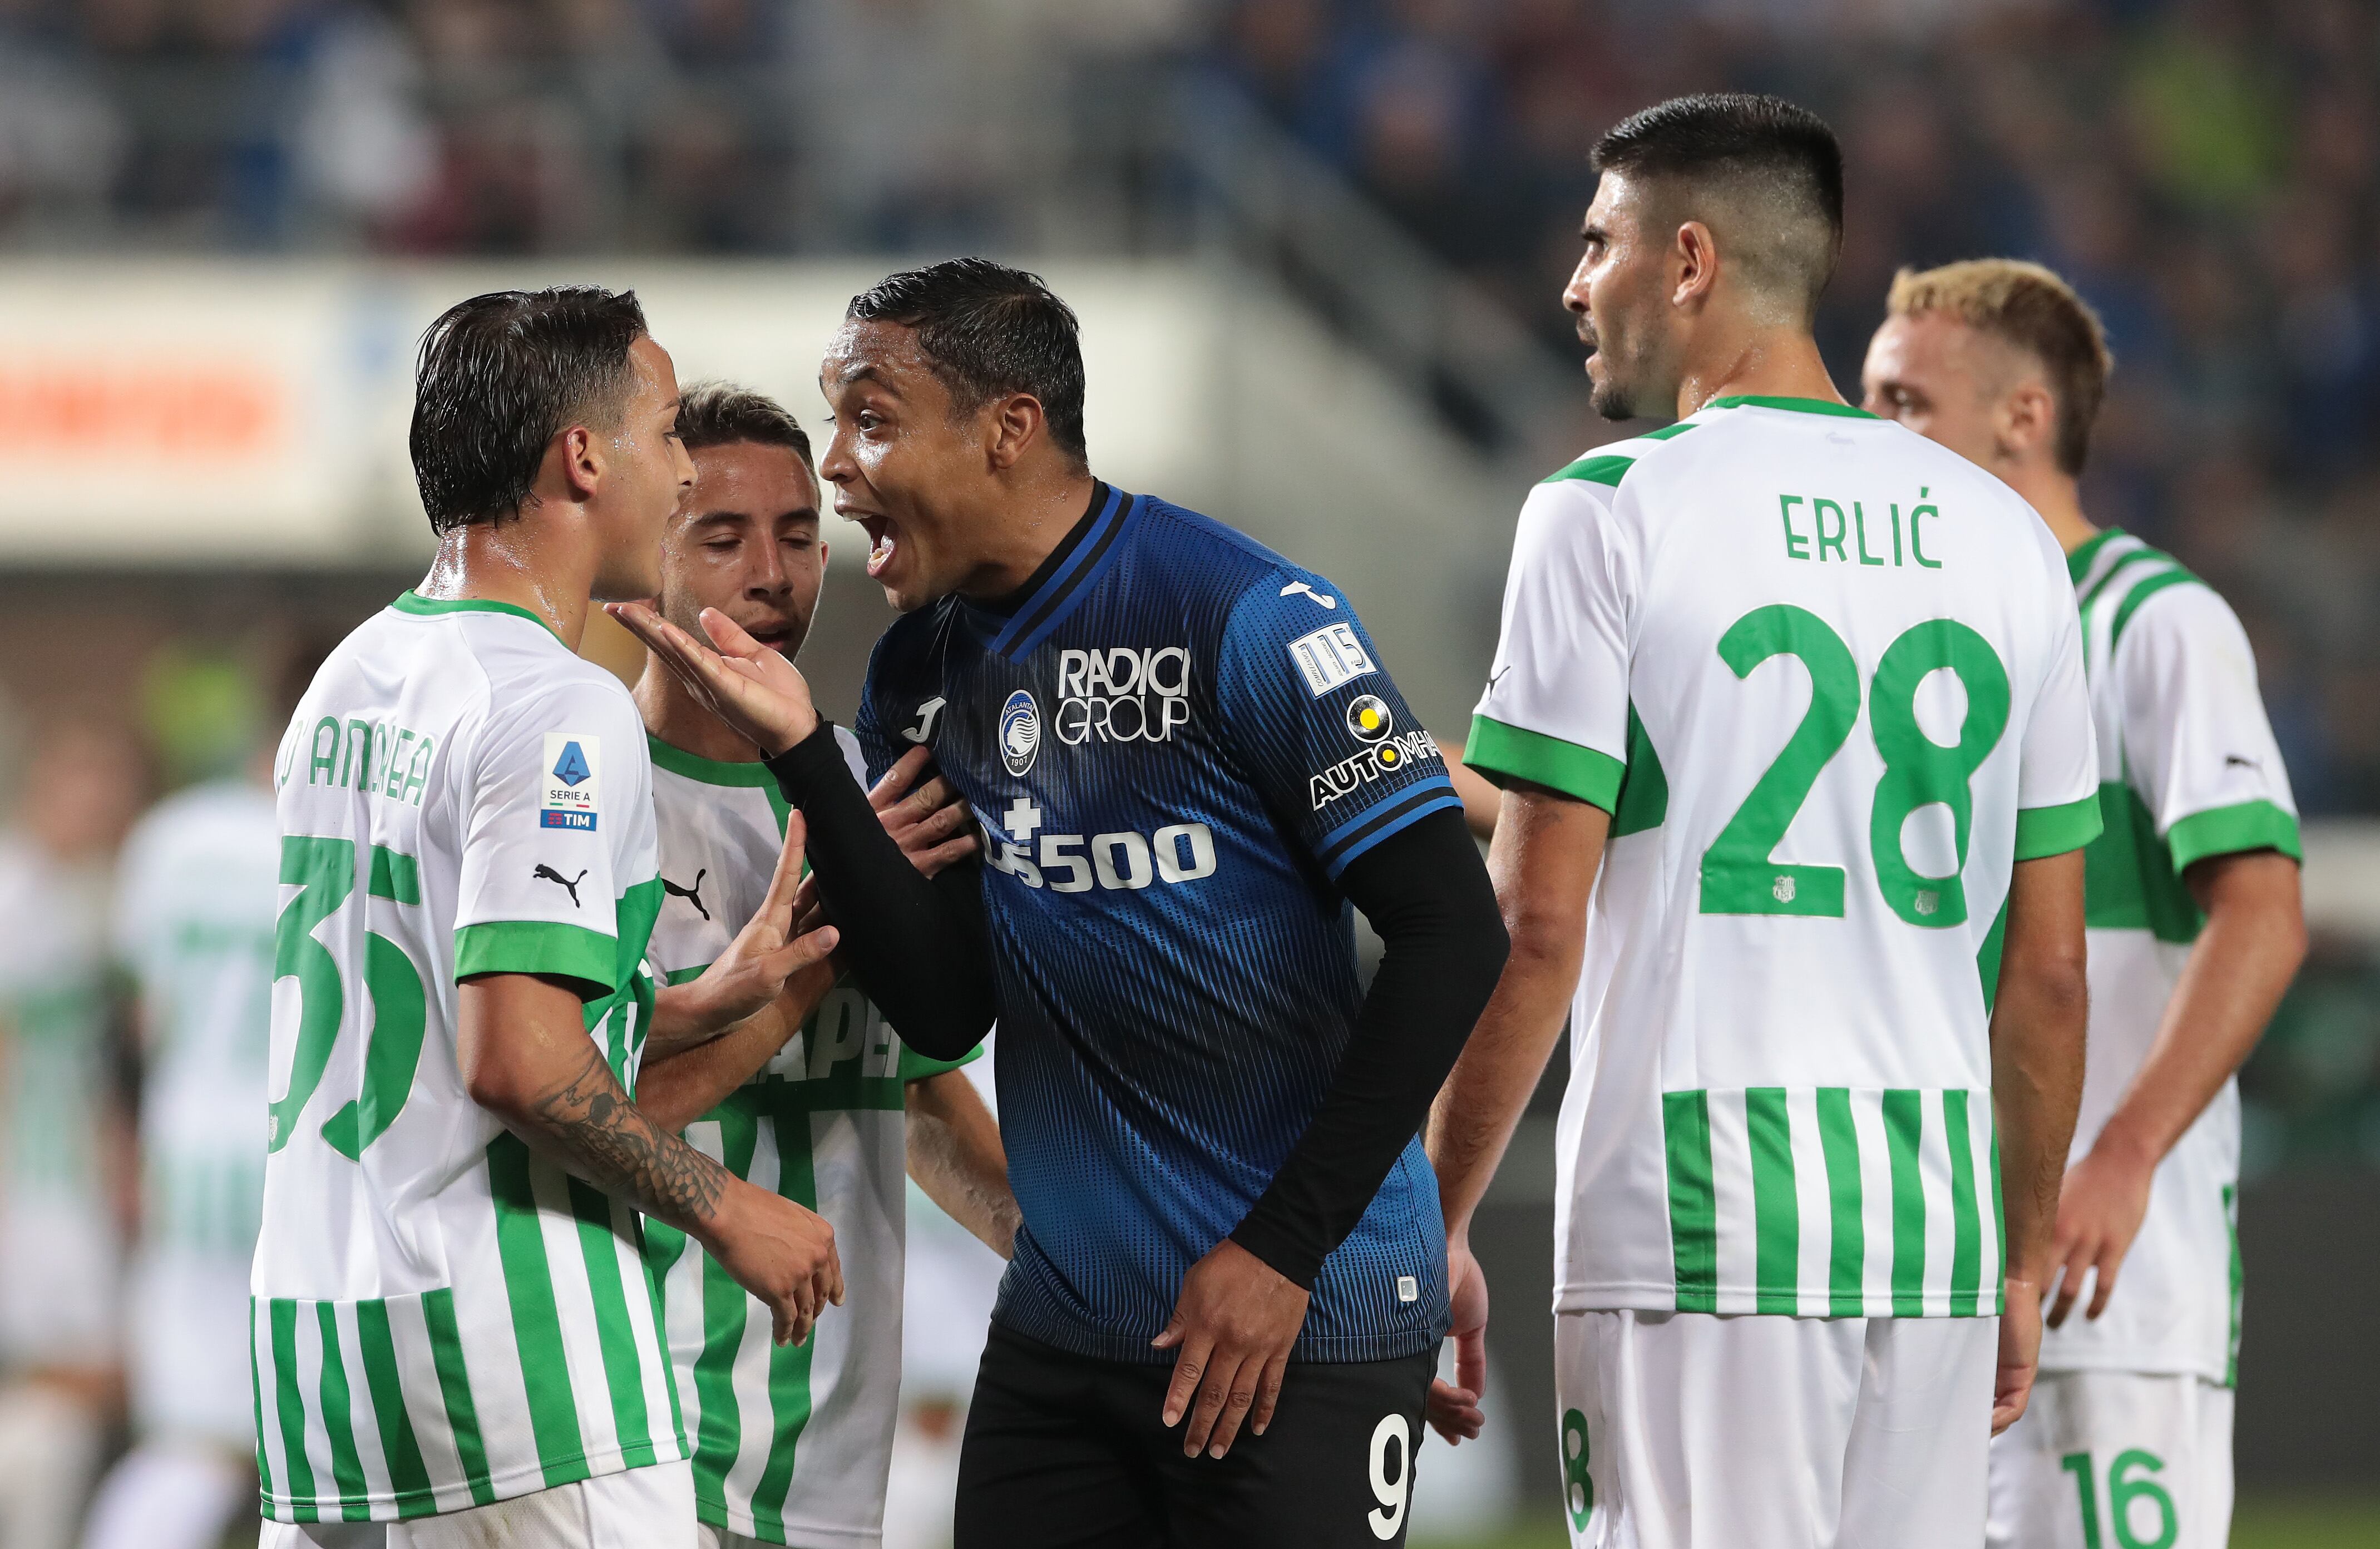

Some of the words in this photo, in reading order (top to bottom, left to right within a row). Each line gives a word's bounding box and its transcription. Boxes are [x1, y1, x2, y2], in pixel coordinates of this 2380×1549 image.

[1780, 487, 1942, 568] ERLIĆ
[1058, 647, 1191, 699] RADICI
[1302, 652, 1324, 686] COMPLEANNO
[1005, 702, 1034, 716] ATALANTA
[1055, 695, 1190, 745] GROUP
[1011, 756, 1028, 766] 1907
[1699, 602, 2011, 928] 28
[550, 790, 580, 800] SERIE
[583, 793, 590, 801] A
[564, 813, 590, 828] TIM
[748, 988, 901, 1086] APEI
[1368, 1413, 1409, 1541] 9
[1562, 1408, 1594, 1534] 8
[2061, 1448, 2178, 1549] 16
